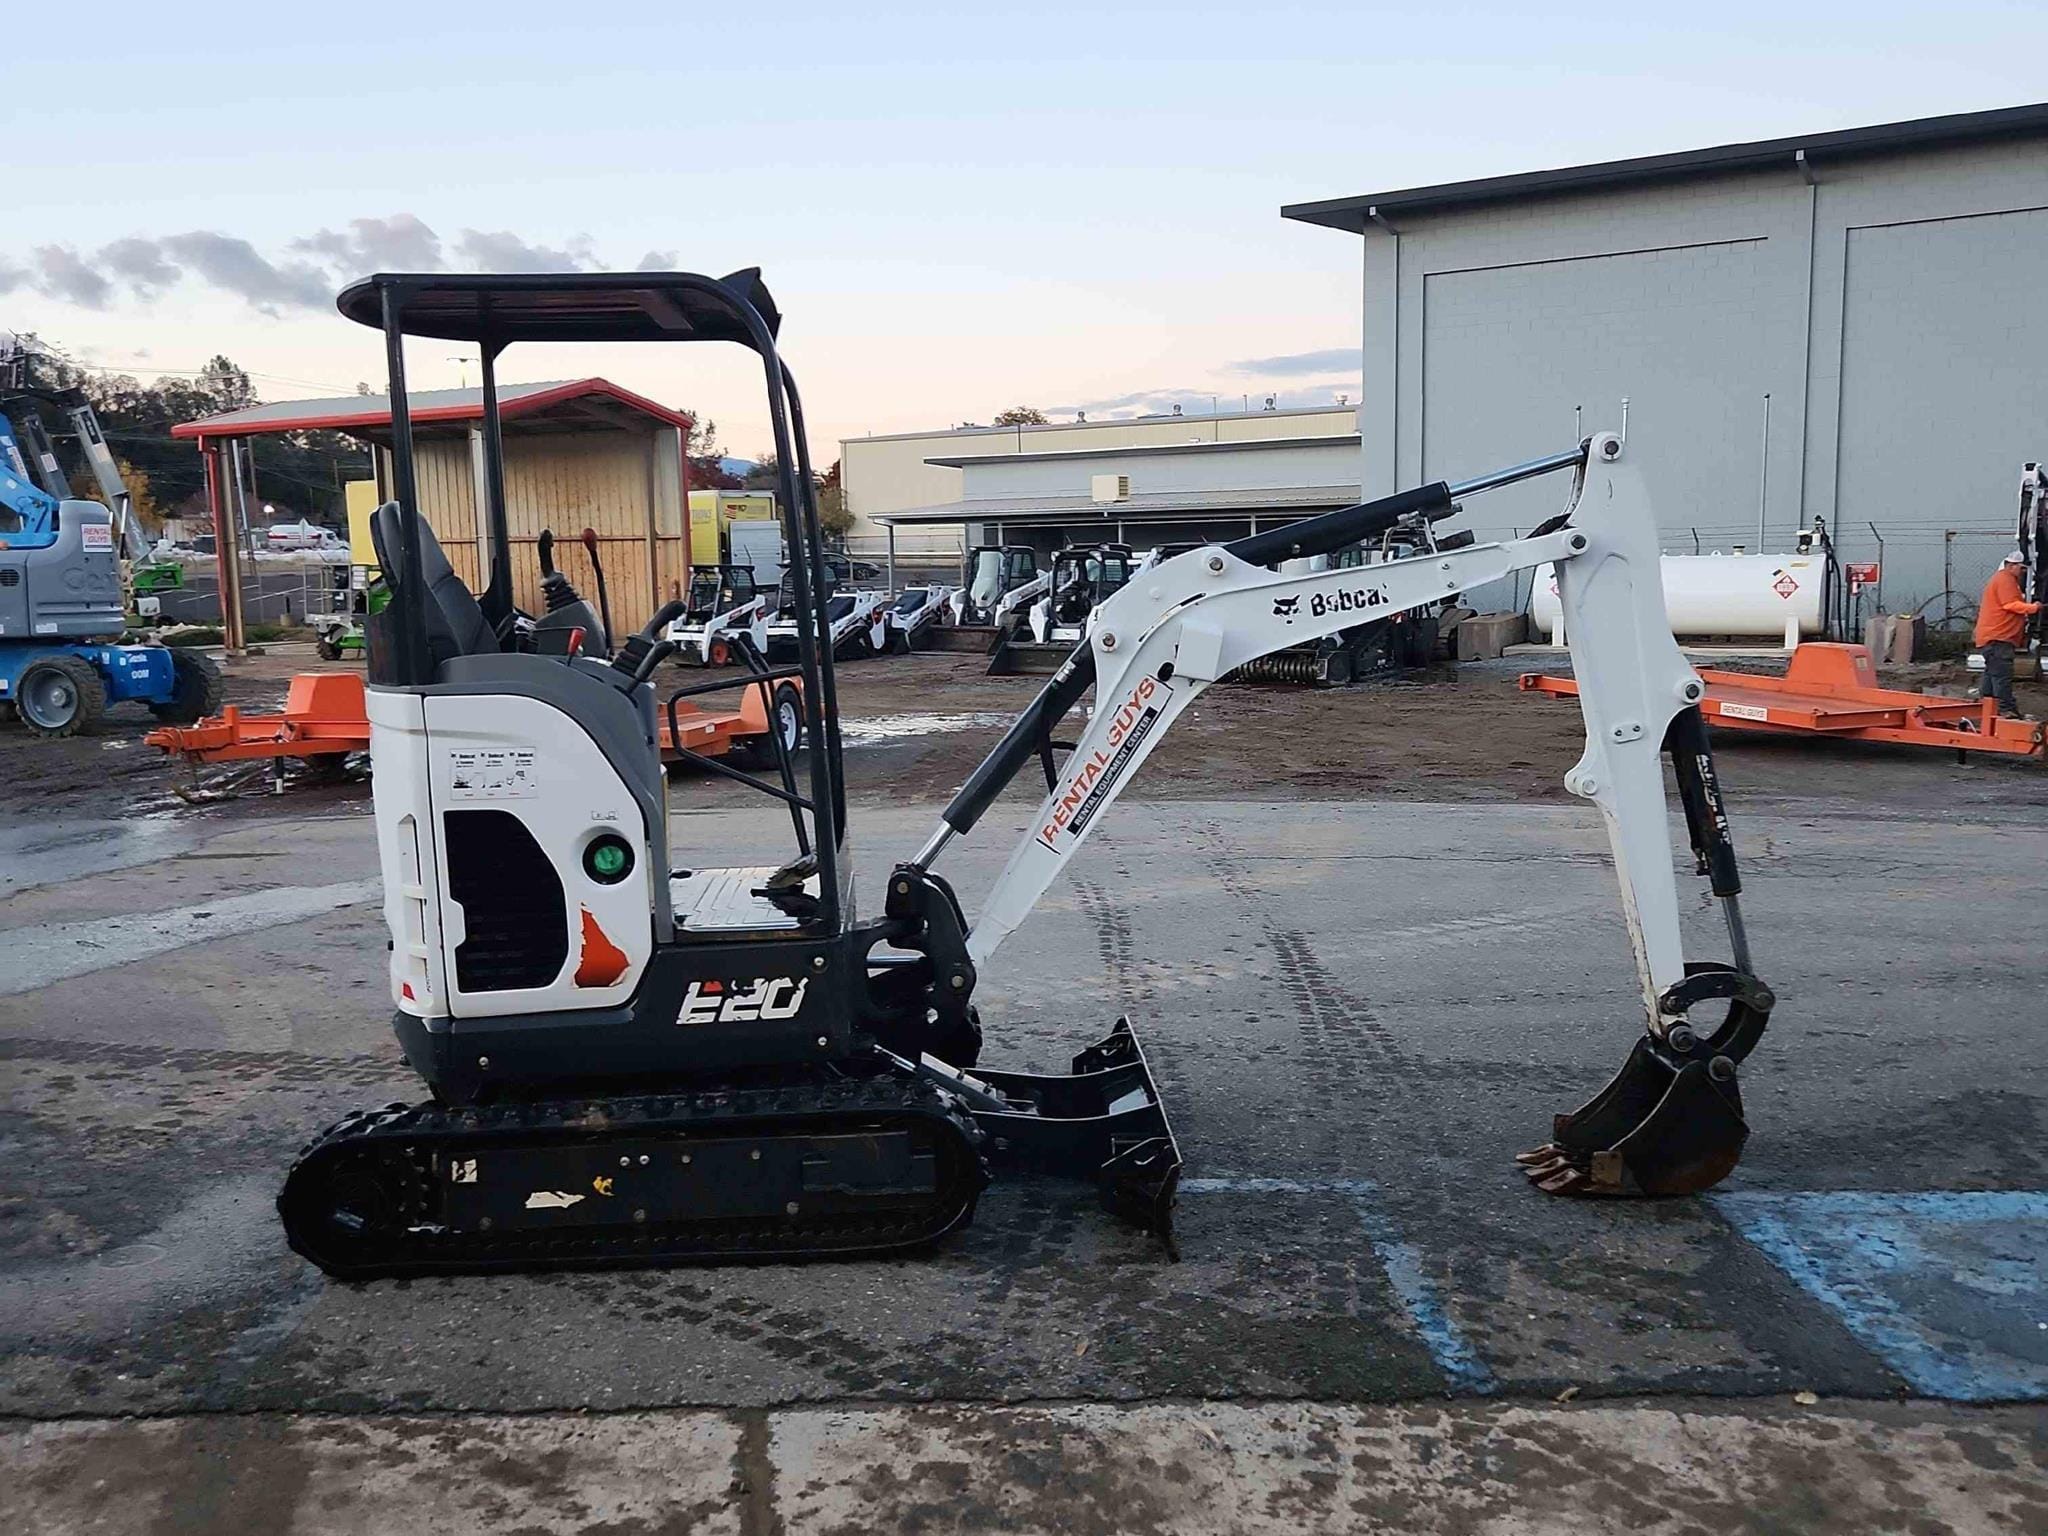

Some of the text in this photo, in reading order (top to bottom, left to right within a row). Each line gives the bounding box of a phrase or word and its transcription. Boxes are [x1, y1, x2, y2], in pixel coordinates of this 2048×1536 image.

[83, 527, 111, 536] RENTAL
[88, 535, 107, 543] GUYS
[1723, 704, 1746, 715] RENTAL
[1042, 677, 1155, 843] RENTAL GUYS
[1075, 714, 1152, 827] RENTAL EQUIPMENT CENTER
[676, 977, 809, 1024] E20
